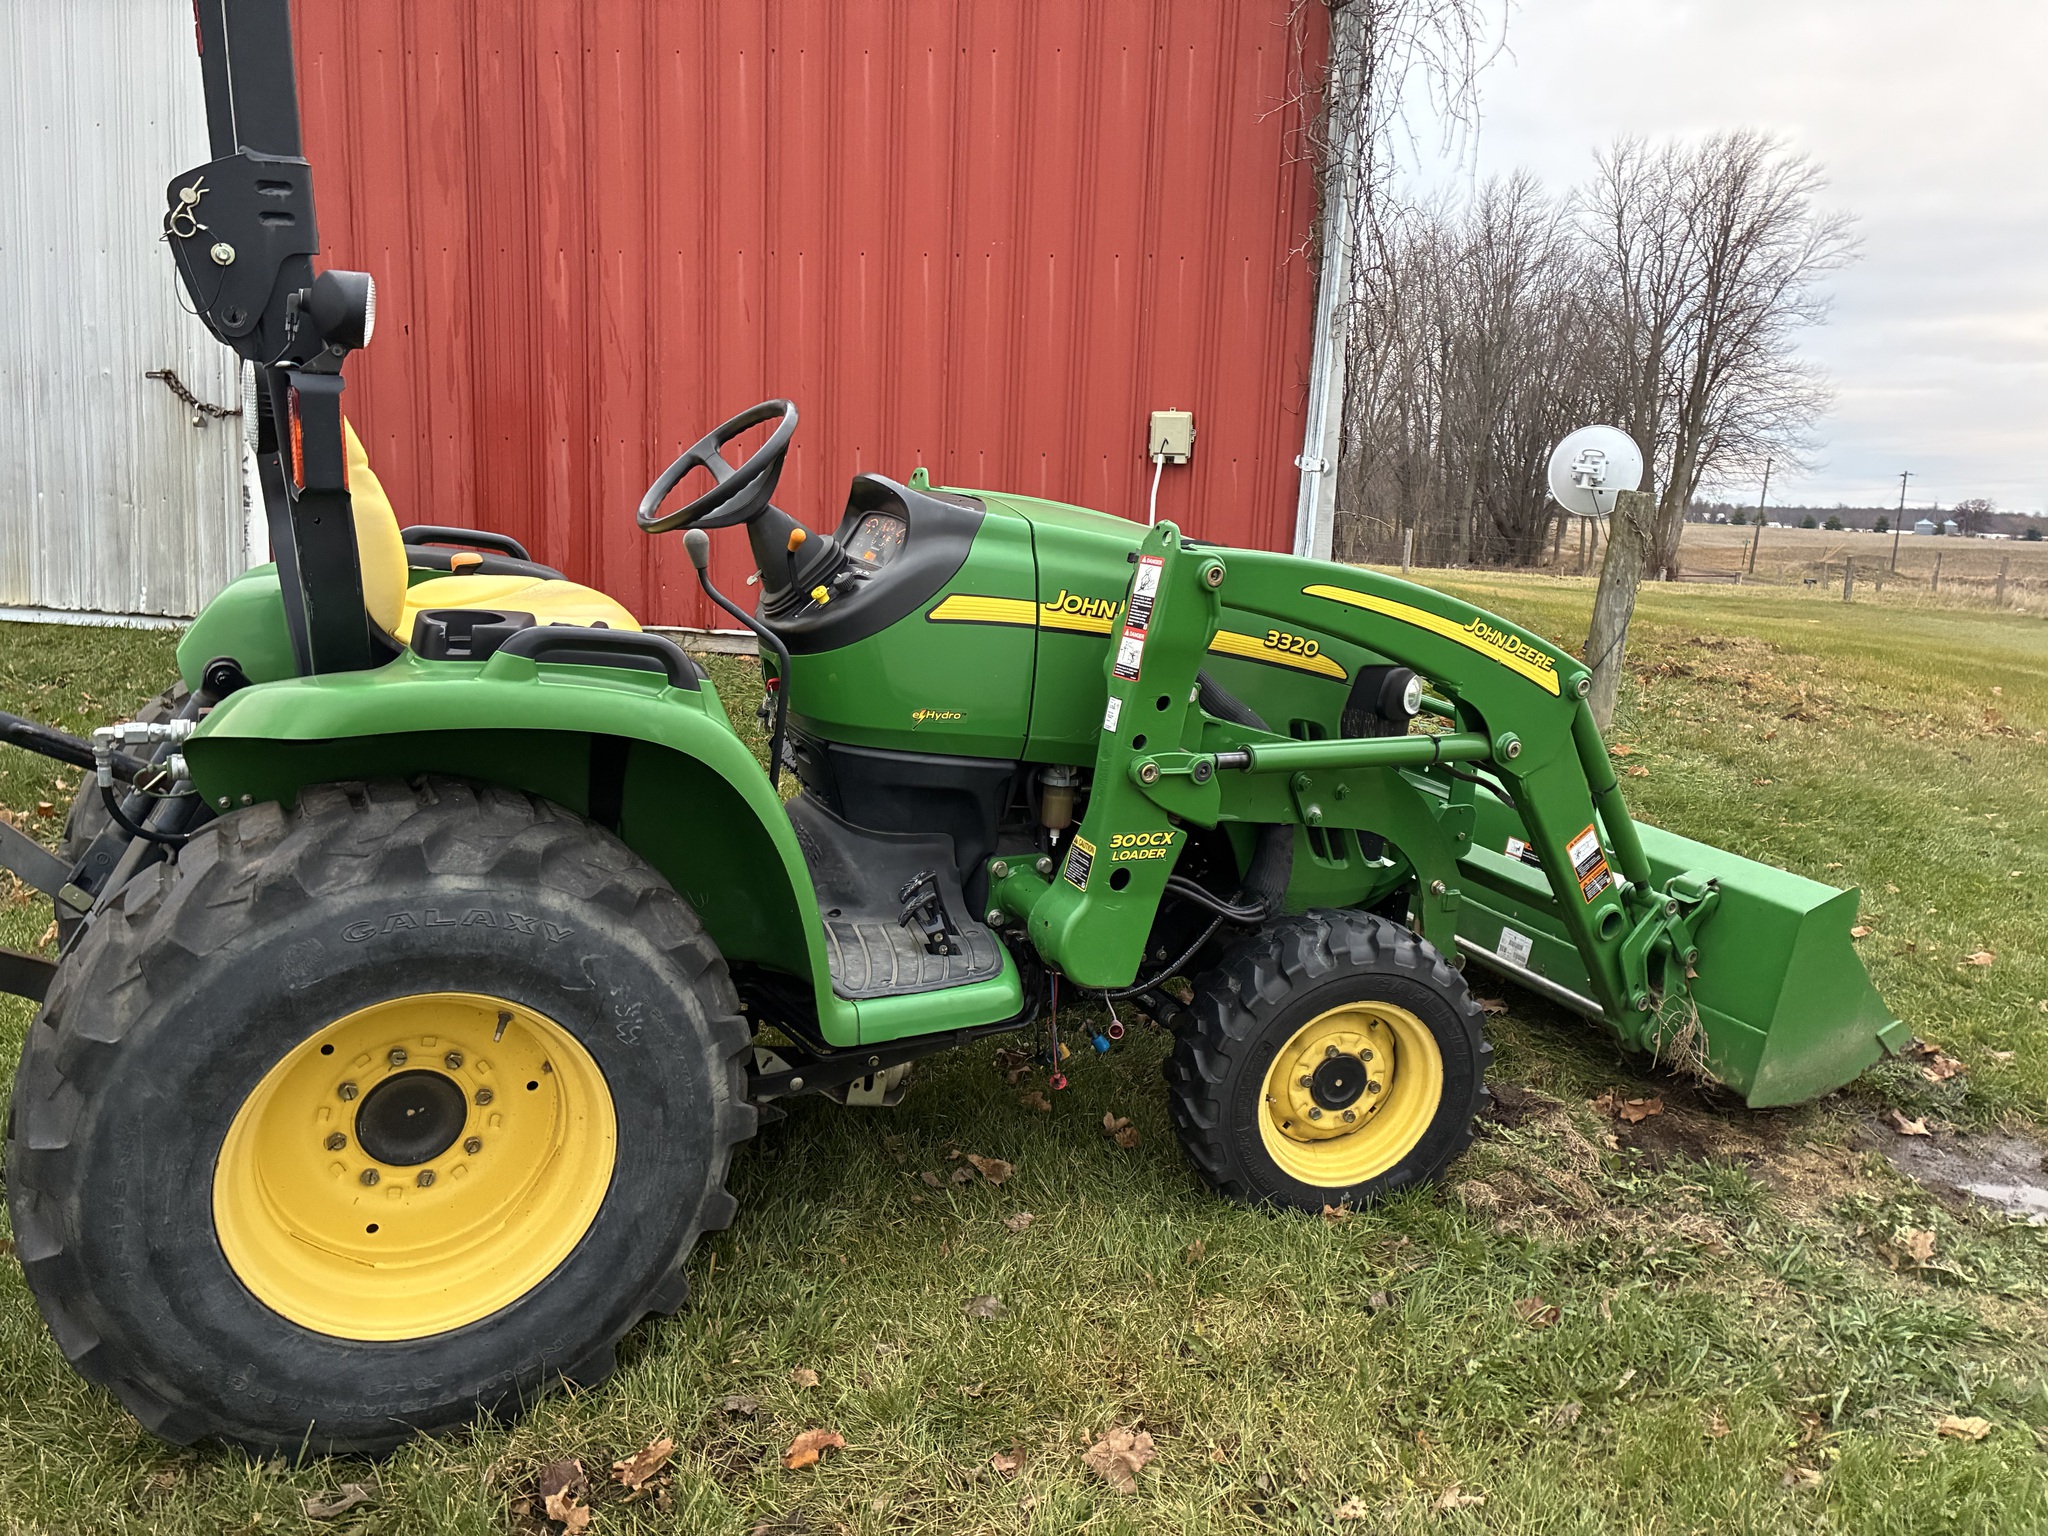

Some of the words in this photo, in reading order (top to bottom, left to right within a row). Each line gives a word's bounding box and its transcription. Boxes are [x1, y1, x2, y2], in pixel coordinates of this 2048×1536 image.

[1045, 590, 1116, 619] JOHN
[1264, 629, 1320, 657] 3320
[1464, 616, 1508, 648] JOHN
[1504, 634, 1555, 671] DEERE
[1110, 831, 1176, 849] 300CX
[1111, 848, 1167, 862] LOADER
[341, 907, 576, 944] GALAXY
